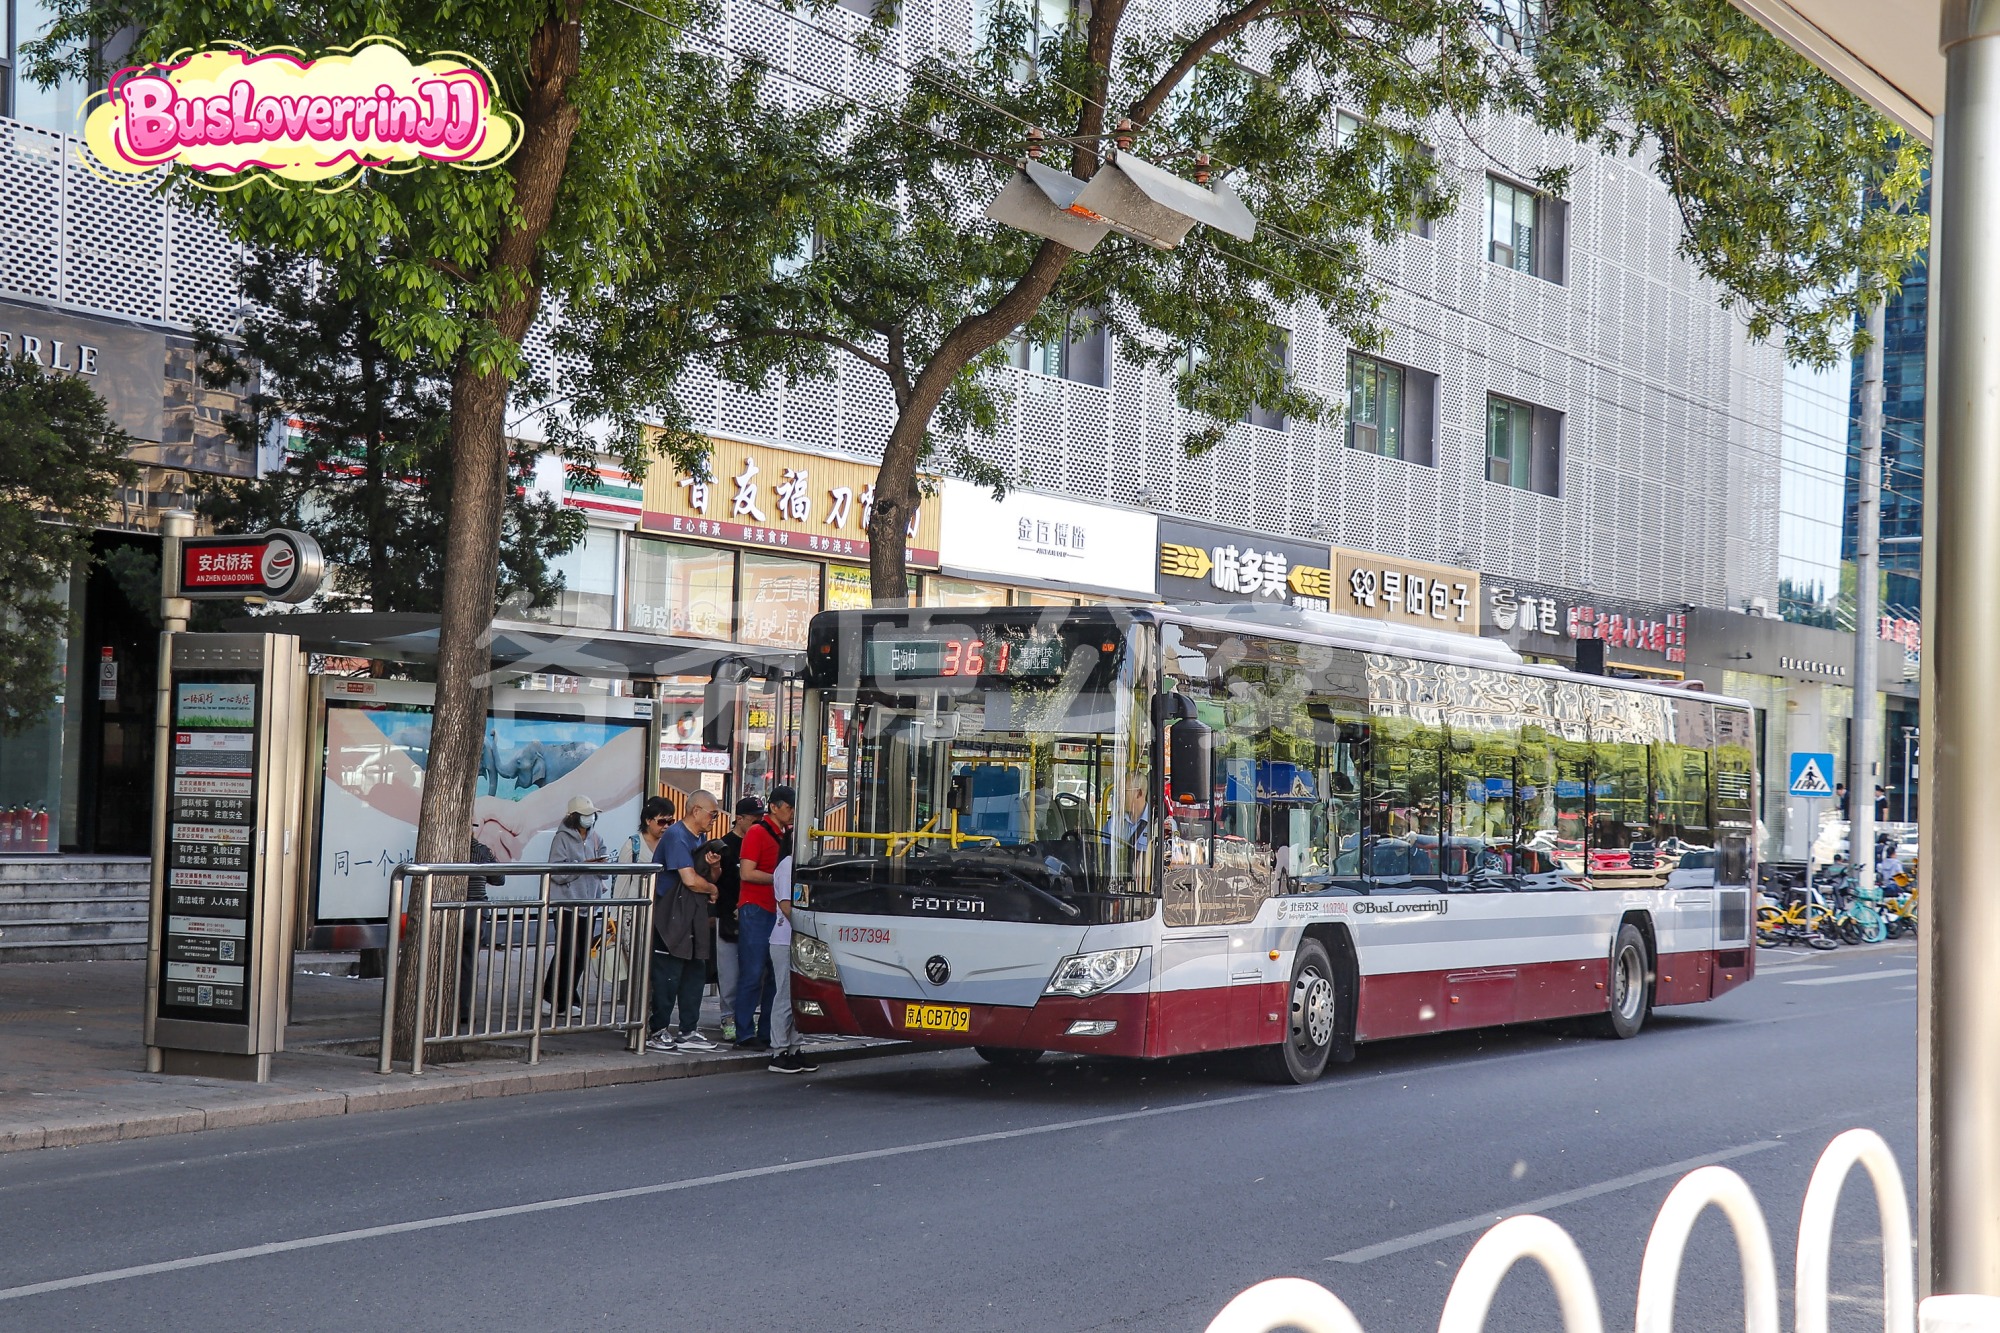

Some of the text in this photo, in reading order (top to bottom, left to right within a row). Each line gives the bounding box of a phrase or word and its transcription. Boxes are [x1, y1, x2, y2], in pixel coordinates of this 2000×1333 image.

[673, 517, 721, 536] 匠心传承
[744, 526, 789, 546] 鲜采食材
[810, 535, 852, 554] 现炒浇头
[199, 553, 254, 571] 安贞桥东
[1211, 544, 1287, 600] 味多美
[1381, 570, 1470, 622] 早阳包子
[892, 649, 917, 671] 巴沟村
[943, 641, 1010, 676] 361
[1023, 658, 1049, 669] 创业园
[181, 799, 243, 809] 排队候车 自觉刷卡
[181, 810, 243, 820] 顺序下车 注意安全
[180, 845, 241, 856] 有序上车 礼貌让座
[180, 856, 241, 866] 尊老爱幼 文明乘车
[177, 895, 240, 907] 清洁城市 人人有责
[912, 896, 985, 913] FOTON
[1290, 902, 1319, 911] 北京公交
[838, 927, 890, 944] 1137394
